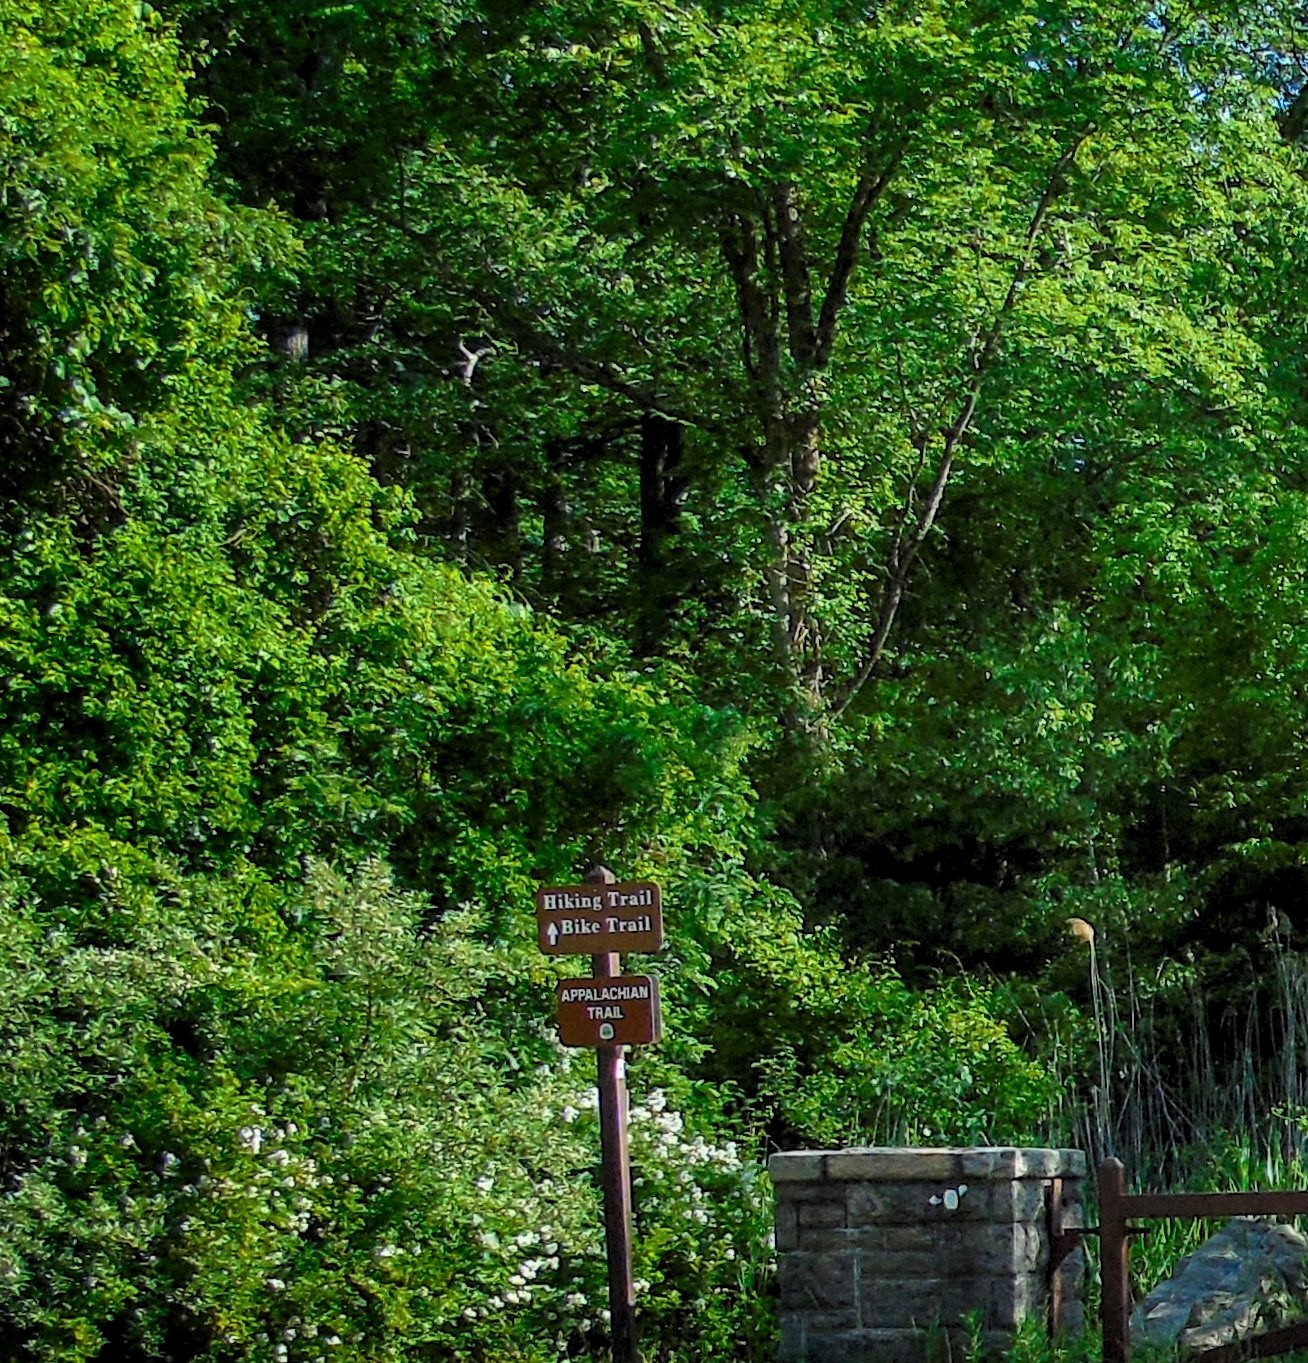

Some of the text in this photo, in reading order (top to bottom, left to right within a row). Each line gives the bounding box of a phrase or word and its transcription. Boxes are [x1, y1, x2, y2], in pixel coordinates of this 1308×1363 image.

[543, 890, 653, 911] Hiking Trail
[561, 916, 651, 935] Bike Trail
[561, 986, 649, 1020] APPALACHIAN TRAIL
